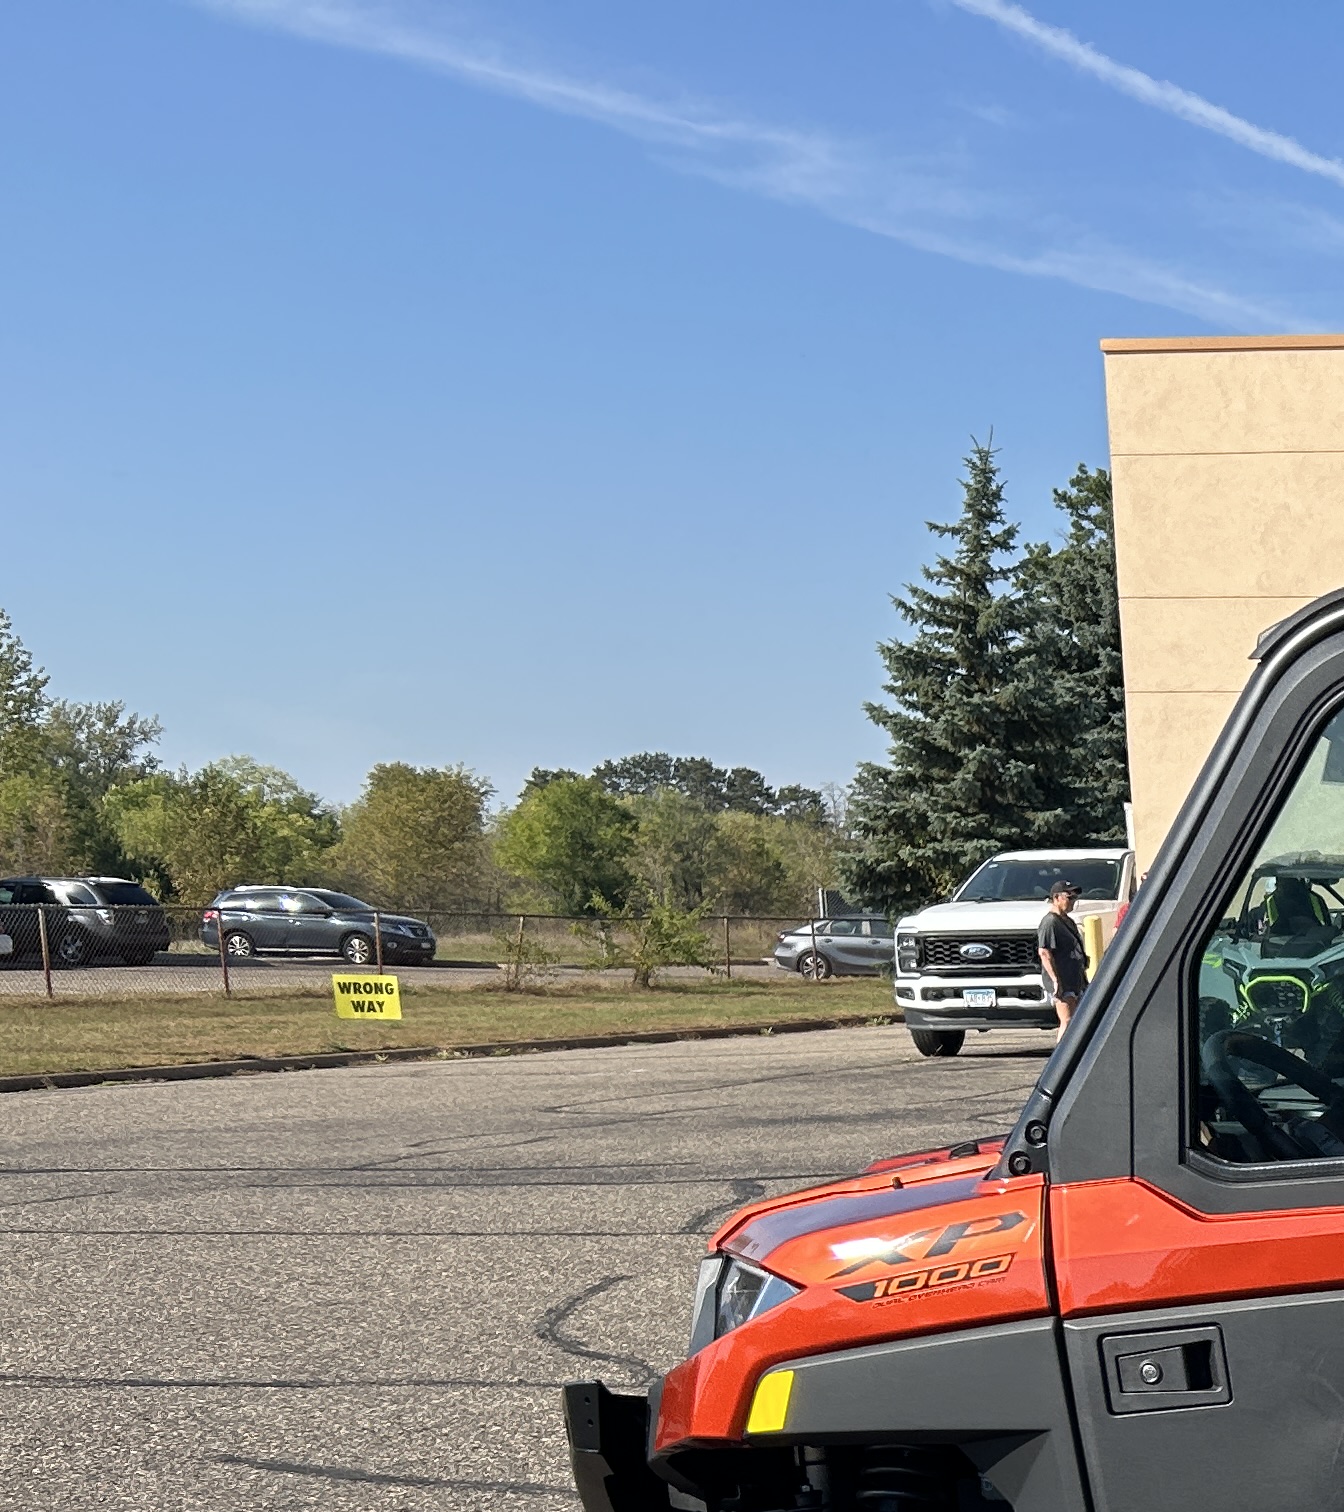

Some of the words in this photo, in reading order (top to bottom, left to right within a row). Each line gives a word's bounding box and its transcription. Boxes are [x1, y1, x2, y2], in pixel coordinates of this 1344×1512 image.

[337, 981, 394, 995] WRONG
[351, 1000, 385, 1013] WAY
[873, 1253, 1013, 1298] 1000
